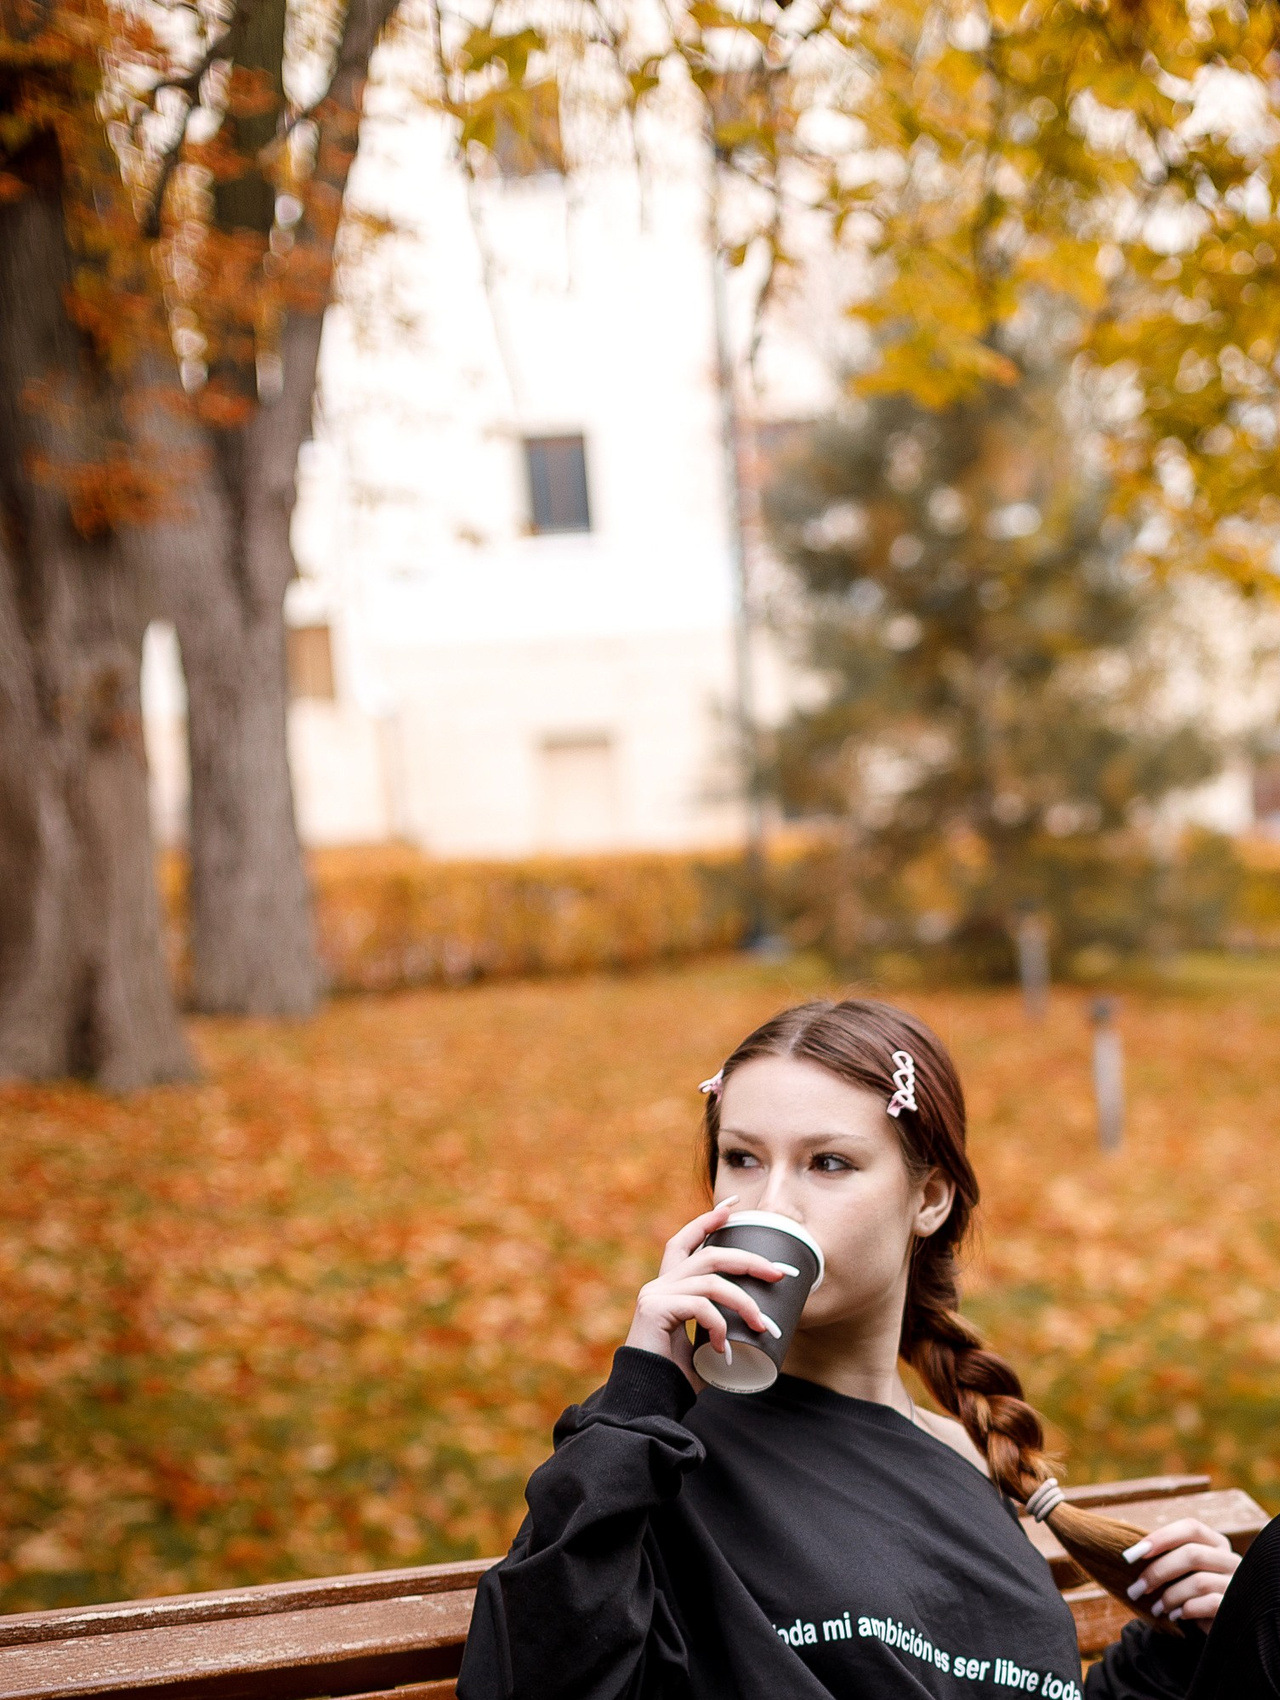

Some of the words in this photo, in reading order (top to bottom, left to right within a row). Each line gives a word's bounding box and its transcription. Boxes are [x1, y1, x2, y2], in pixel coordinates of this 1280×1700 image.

[771, 1618, 818, 1647] oda
[822, 1611, 852, 1642] mi
[857, 1616, 933, 1663] ambición
[933, 1648, 951, 1673] es
[953, 1656, 991, 1681] ser
[993, 1658, 1039, 1692] libre
